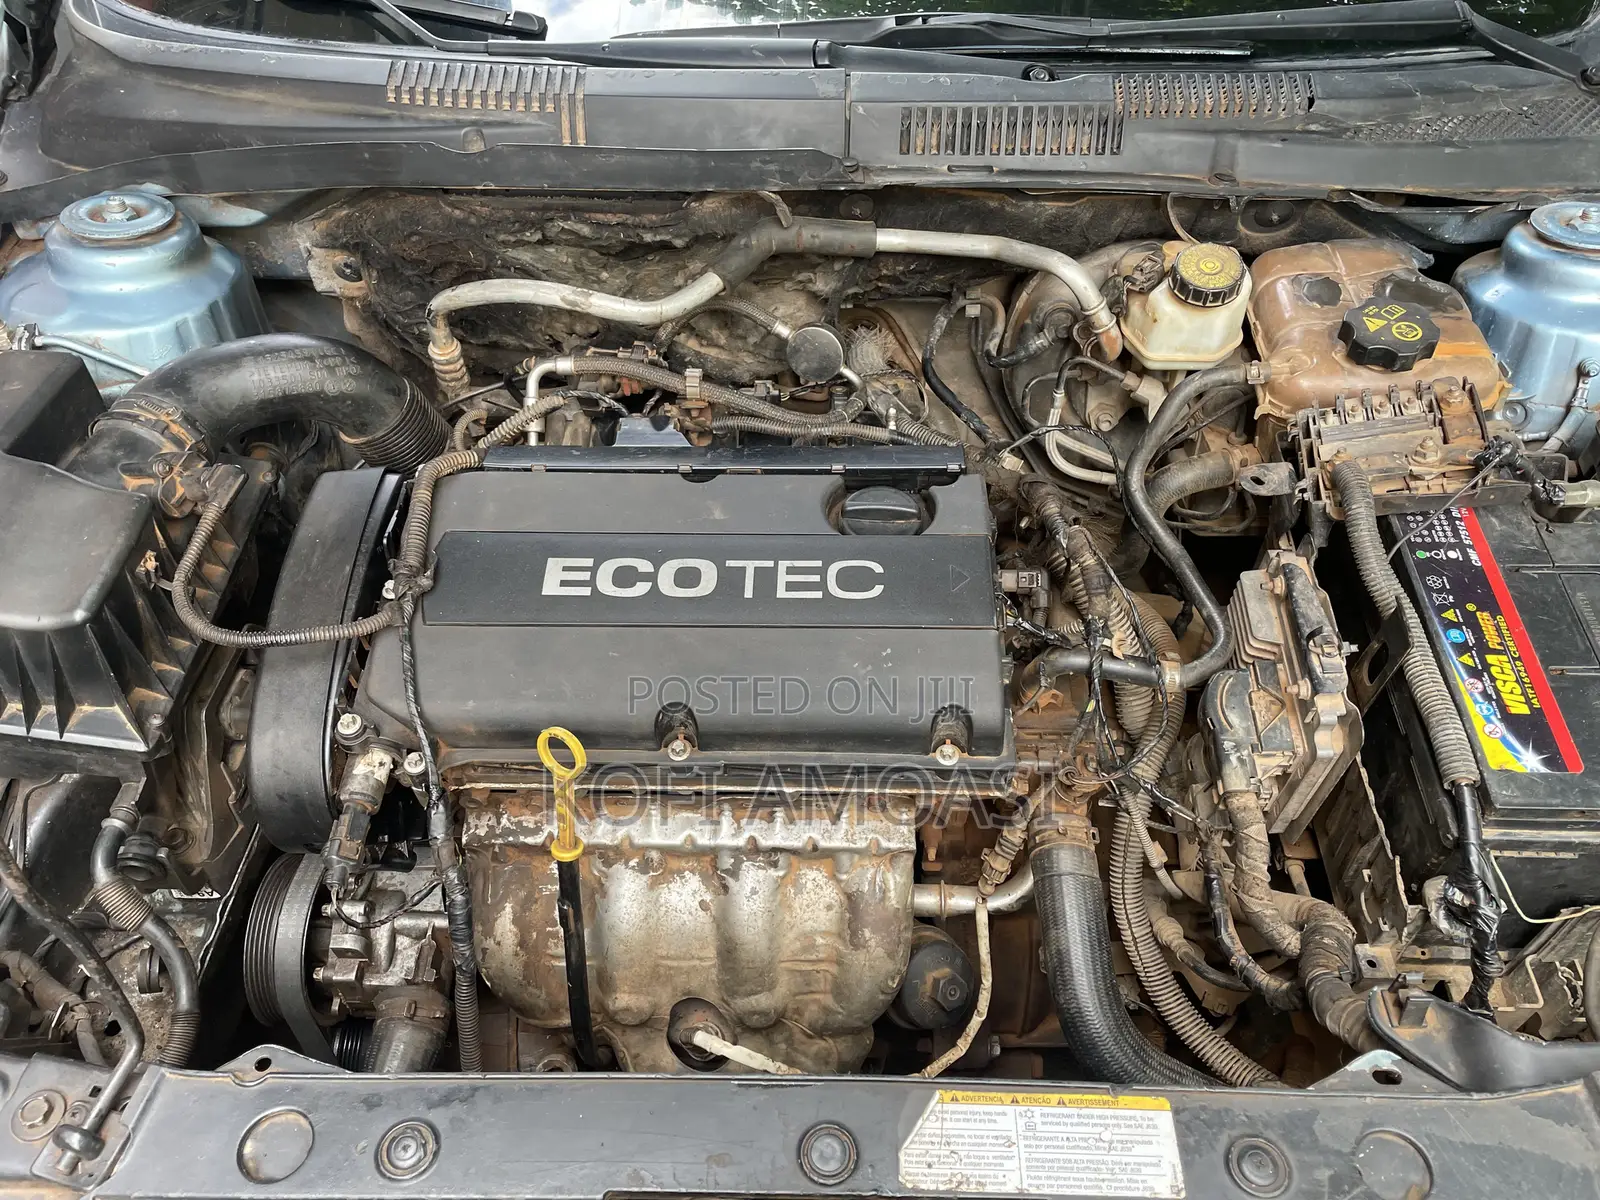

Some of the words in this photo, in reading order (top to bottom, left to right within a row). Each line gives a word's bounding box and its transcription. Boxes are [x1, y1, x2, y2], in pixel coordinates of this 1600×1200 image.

[1455, 520, 1474, 546] 57512
[1466, 547, 1482, 567] CMF
[540, 557, 886, 600] ECOTEC
[1477, 610, 1501, 650] POWER
[1497, 614, 1519, 658] CERTIFIED
[1488, 654, 1531, 715] VISCA
[1513, 661, 1541, 709] IATF16949
[1021, 1096, 1051, 1105] ATENÇÃO
[1067, 1098, 1119, 1107] AVERTISSEMENT
[1039, 1112, 1077, 1120] REFRIGERANT
[1096, 1113, 1109, 1121] HIGH
[1070, 1120, 1092, 1128] qualified
[1022, 1134, 1060, 1142] REFRIGERANTE
[1024, 1156, 1062, 1165] REFRIGERANTE
